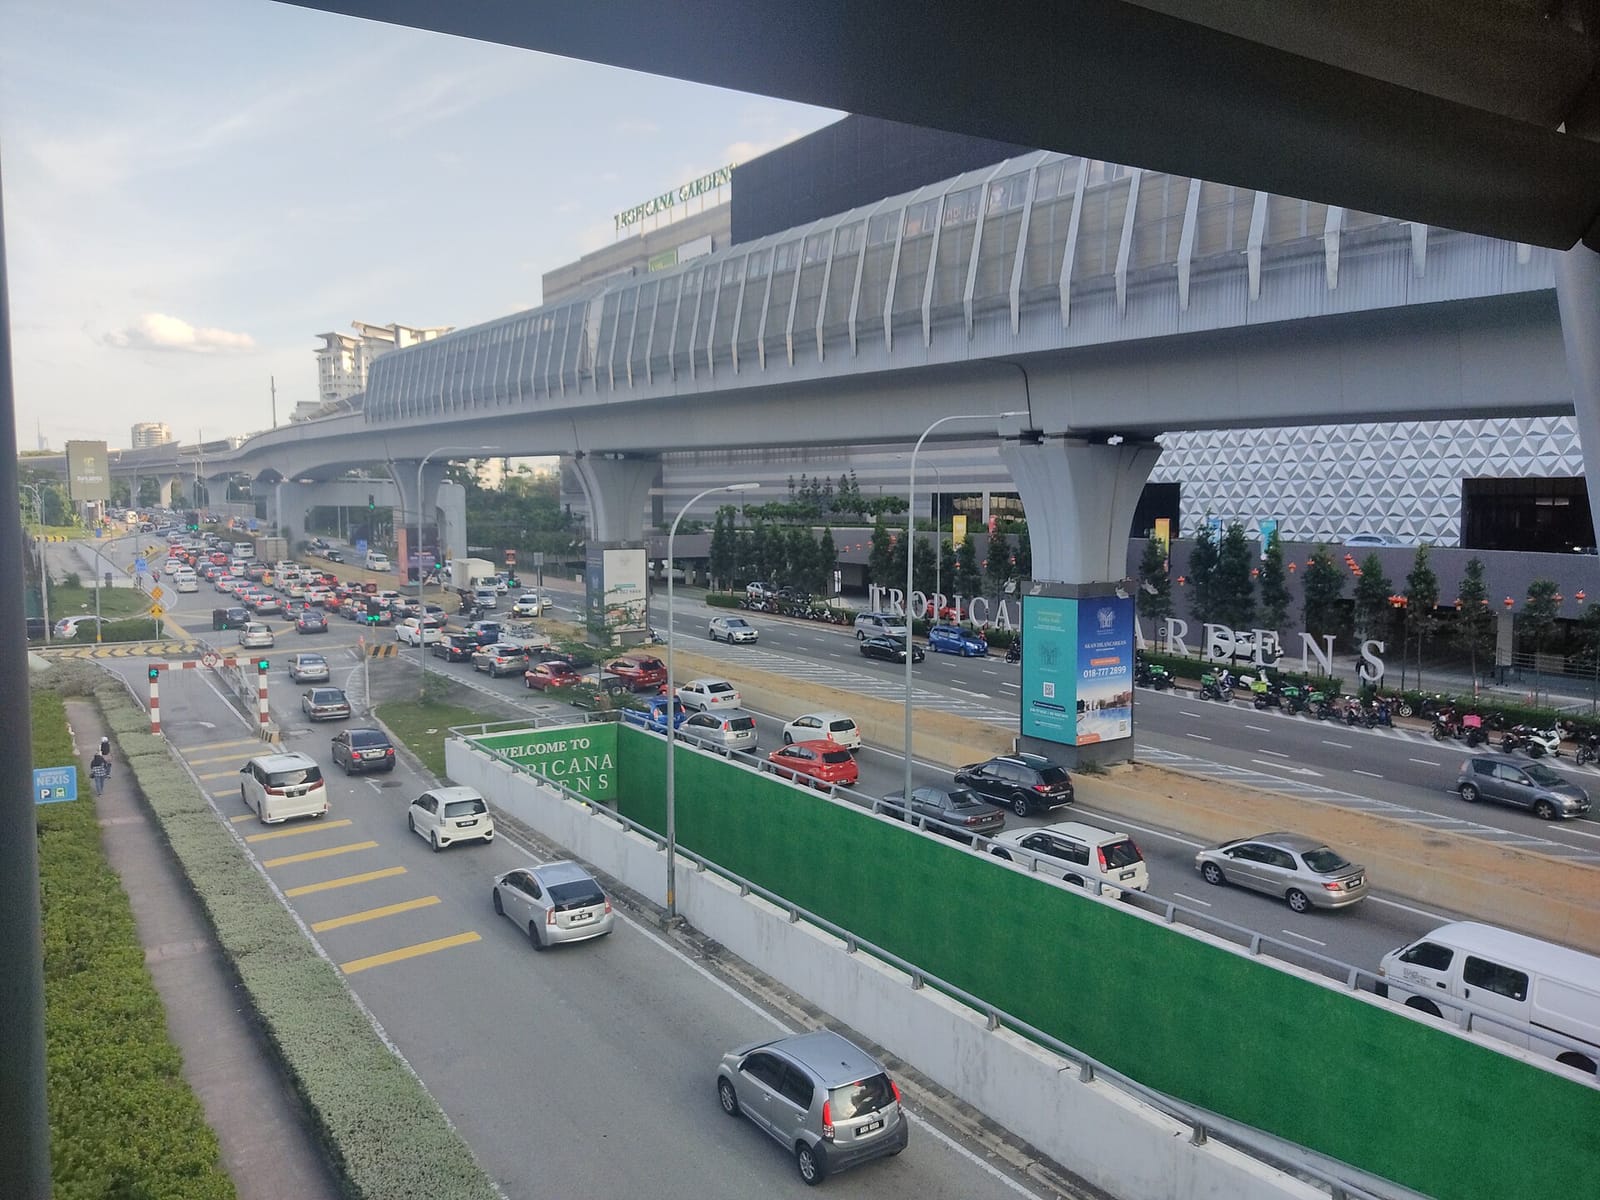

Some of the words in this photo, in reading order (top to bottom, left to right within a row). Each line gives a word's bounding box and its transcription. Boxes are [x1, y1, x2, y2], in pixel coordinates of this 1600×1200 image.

[613, 190, 675, 231] TROPICANA
[869, 583, 1021, 632] TROPICA
[1134, 614, 1385, 682] ARDENS
[495, 741, 567, 758] WELCOME
[570, 738, 590, 750] TO
[526, 753, 614, 777] PICANA
[36, 774, 70, 787] NEXIS
